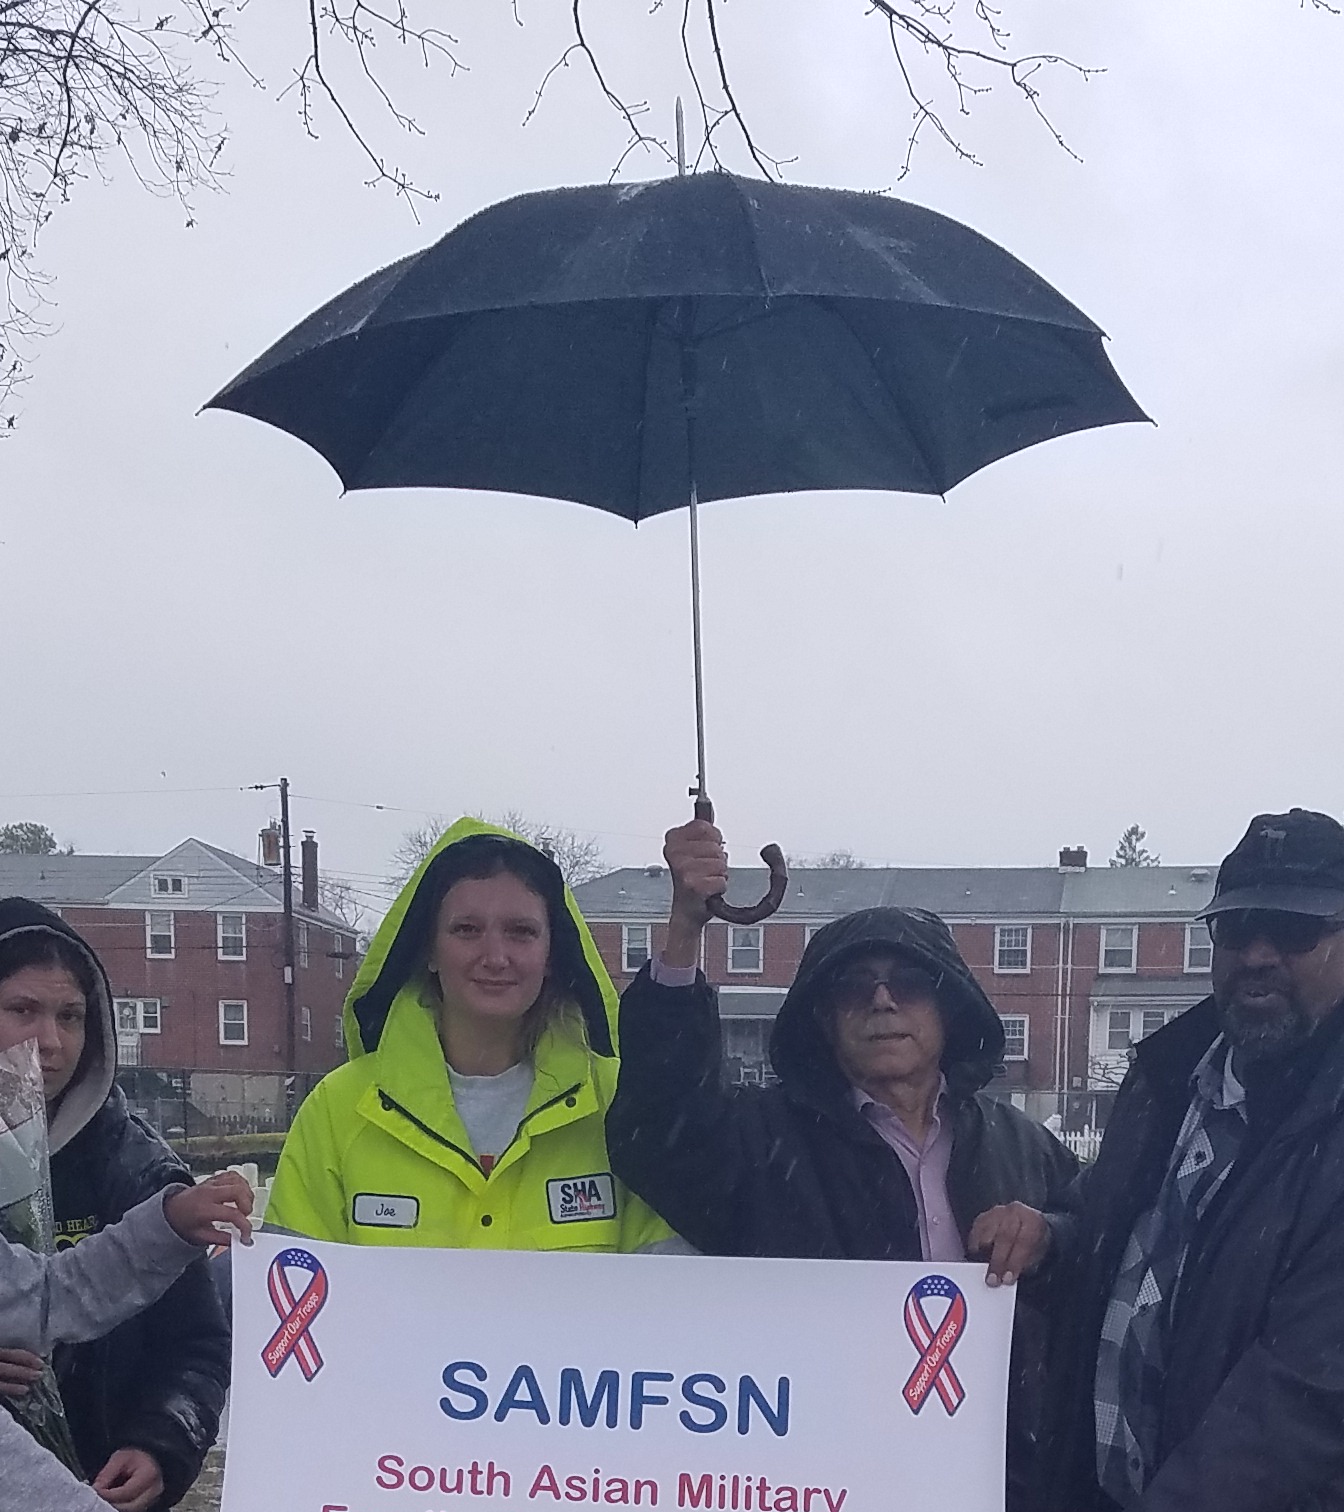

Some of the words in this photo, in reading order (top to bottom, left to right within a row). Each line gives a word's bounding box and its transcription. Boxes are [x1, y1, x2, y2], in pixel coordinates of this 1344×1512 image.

[375, 1203, 396, 1217] Joe
[559, 1203, 578, 1213] State
[560, 1180, 602, 1205] SHA
[267, 1329, 292, 1365] Support
[287, 1317, 302, 1335] Our
[296, 1292, 319, 1320] Troops
[909, 1363, 933, 1401] Support
[926, 1348, 942, 1367] Our
[936, 1320, 958, 1350] Troops
[439, 1360, 790, 1437] SAMFSN
[375, 1454, 511, 1498] South
[528, 1464, 658, 1507] Asian
